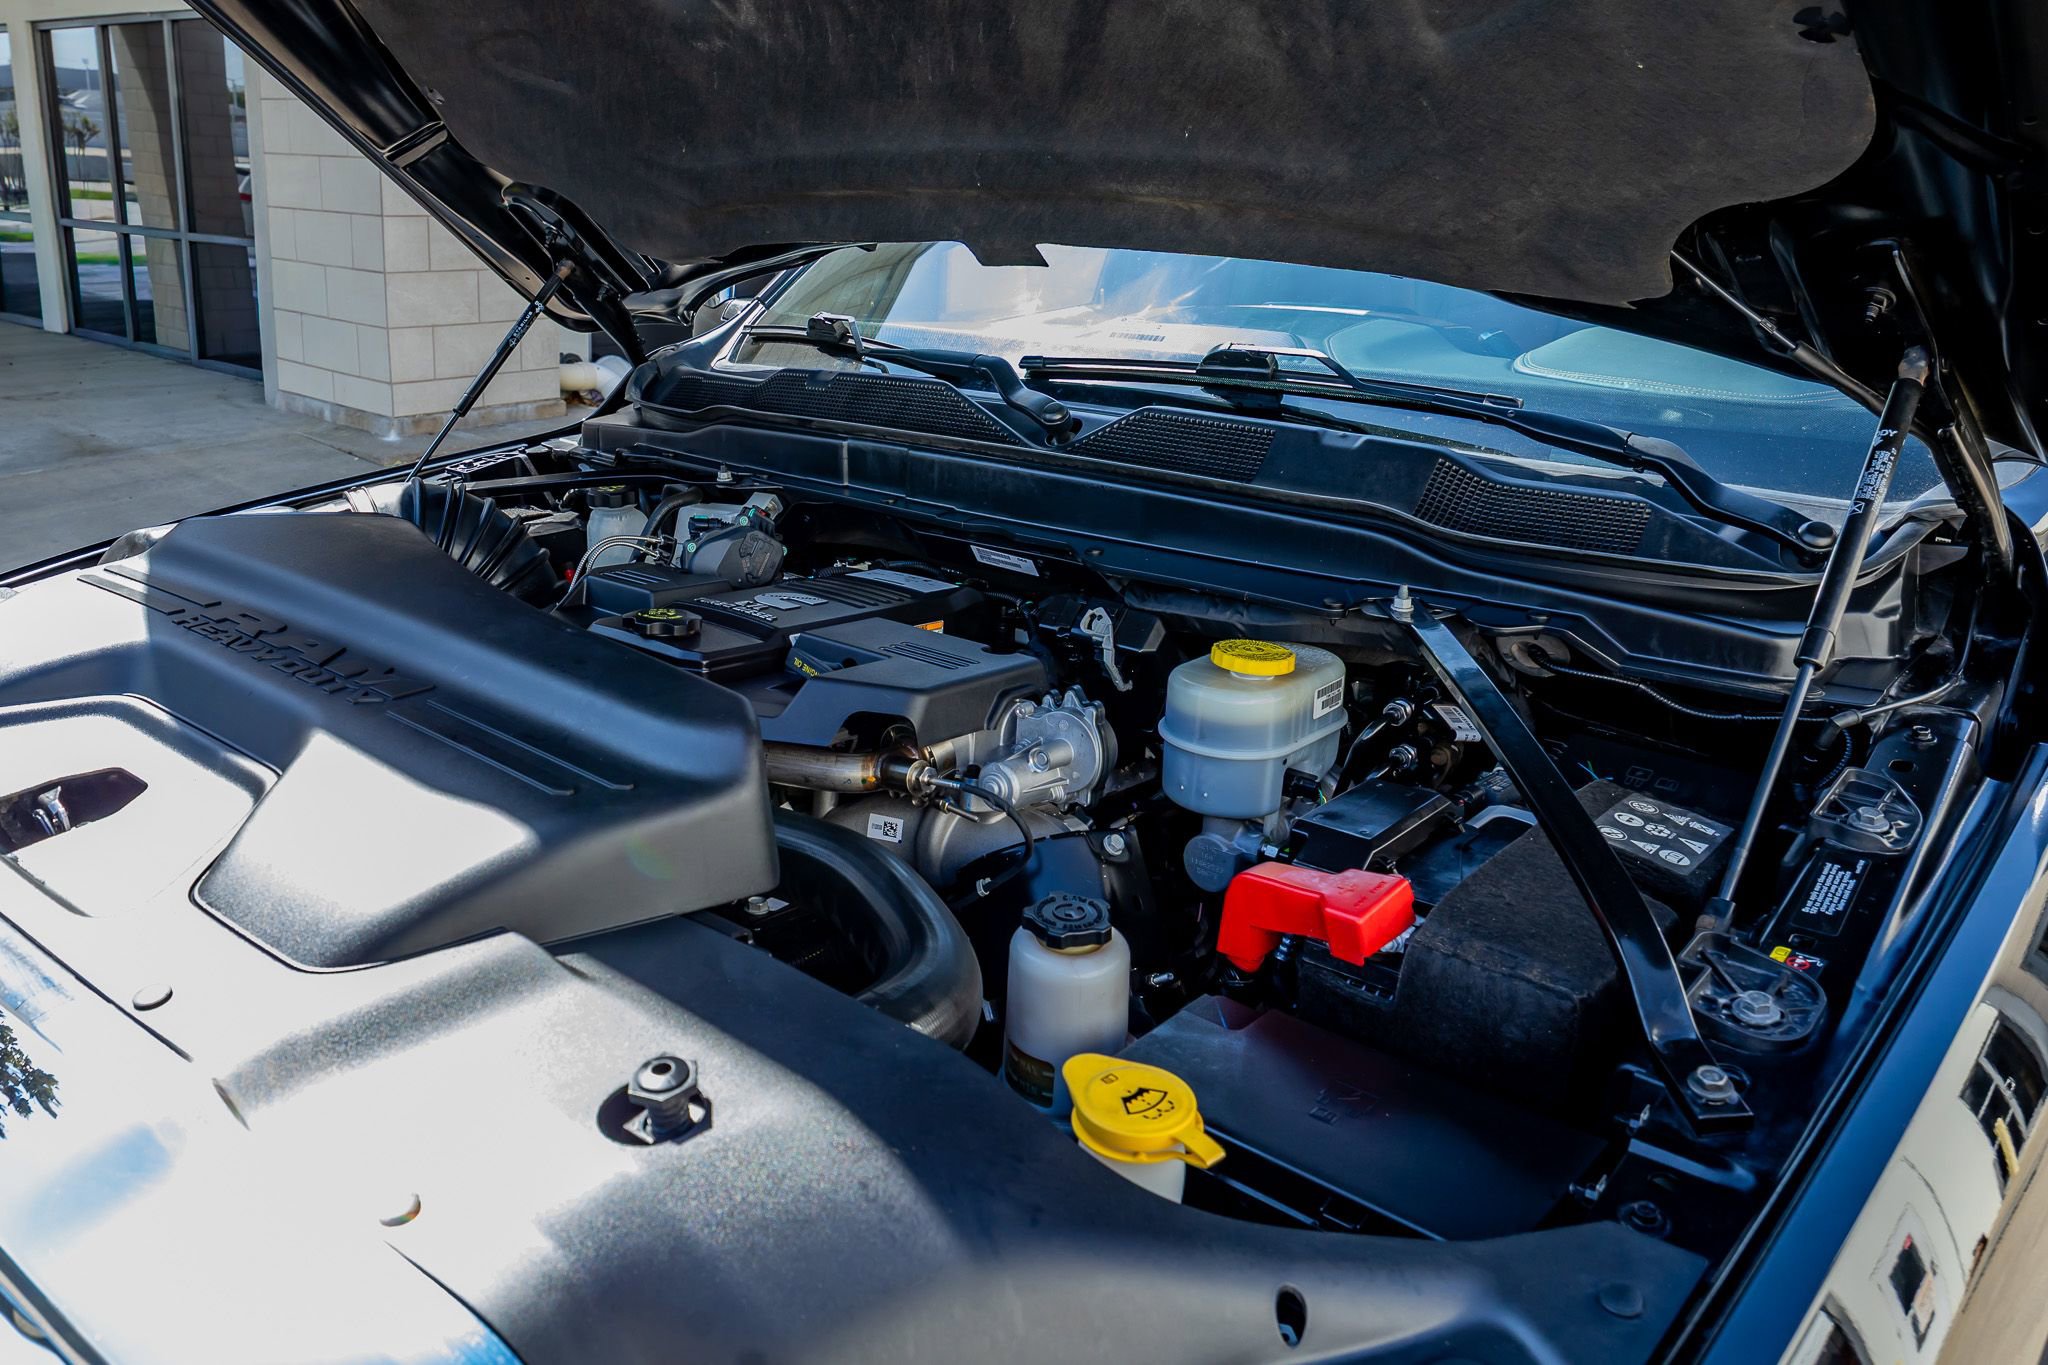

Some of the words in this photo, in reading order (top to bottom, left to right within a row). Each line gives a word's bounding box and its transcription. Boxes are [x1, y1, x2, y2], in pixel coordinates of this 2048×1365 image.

[513, 311, 533, 337] STABILUS
[171, 614, 286, 662] HEAVY
[270, 658, 386, 705] DUTY
[200, 604, 437, 701] RAM
